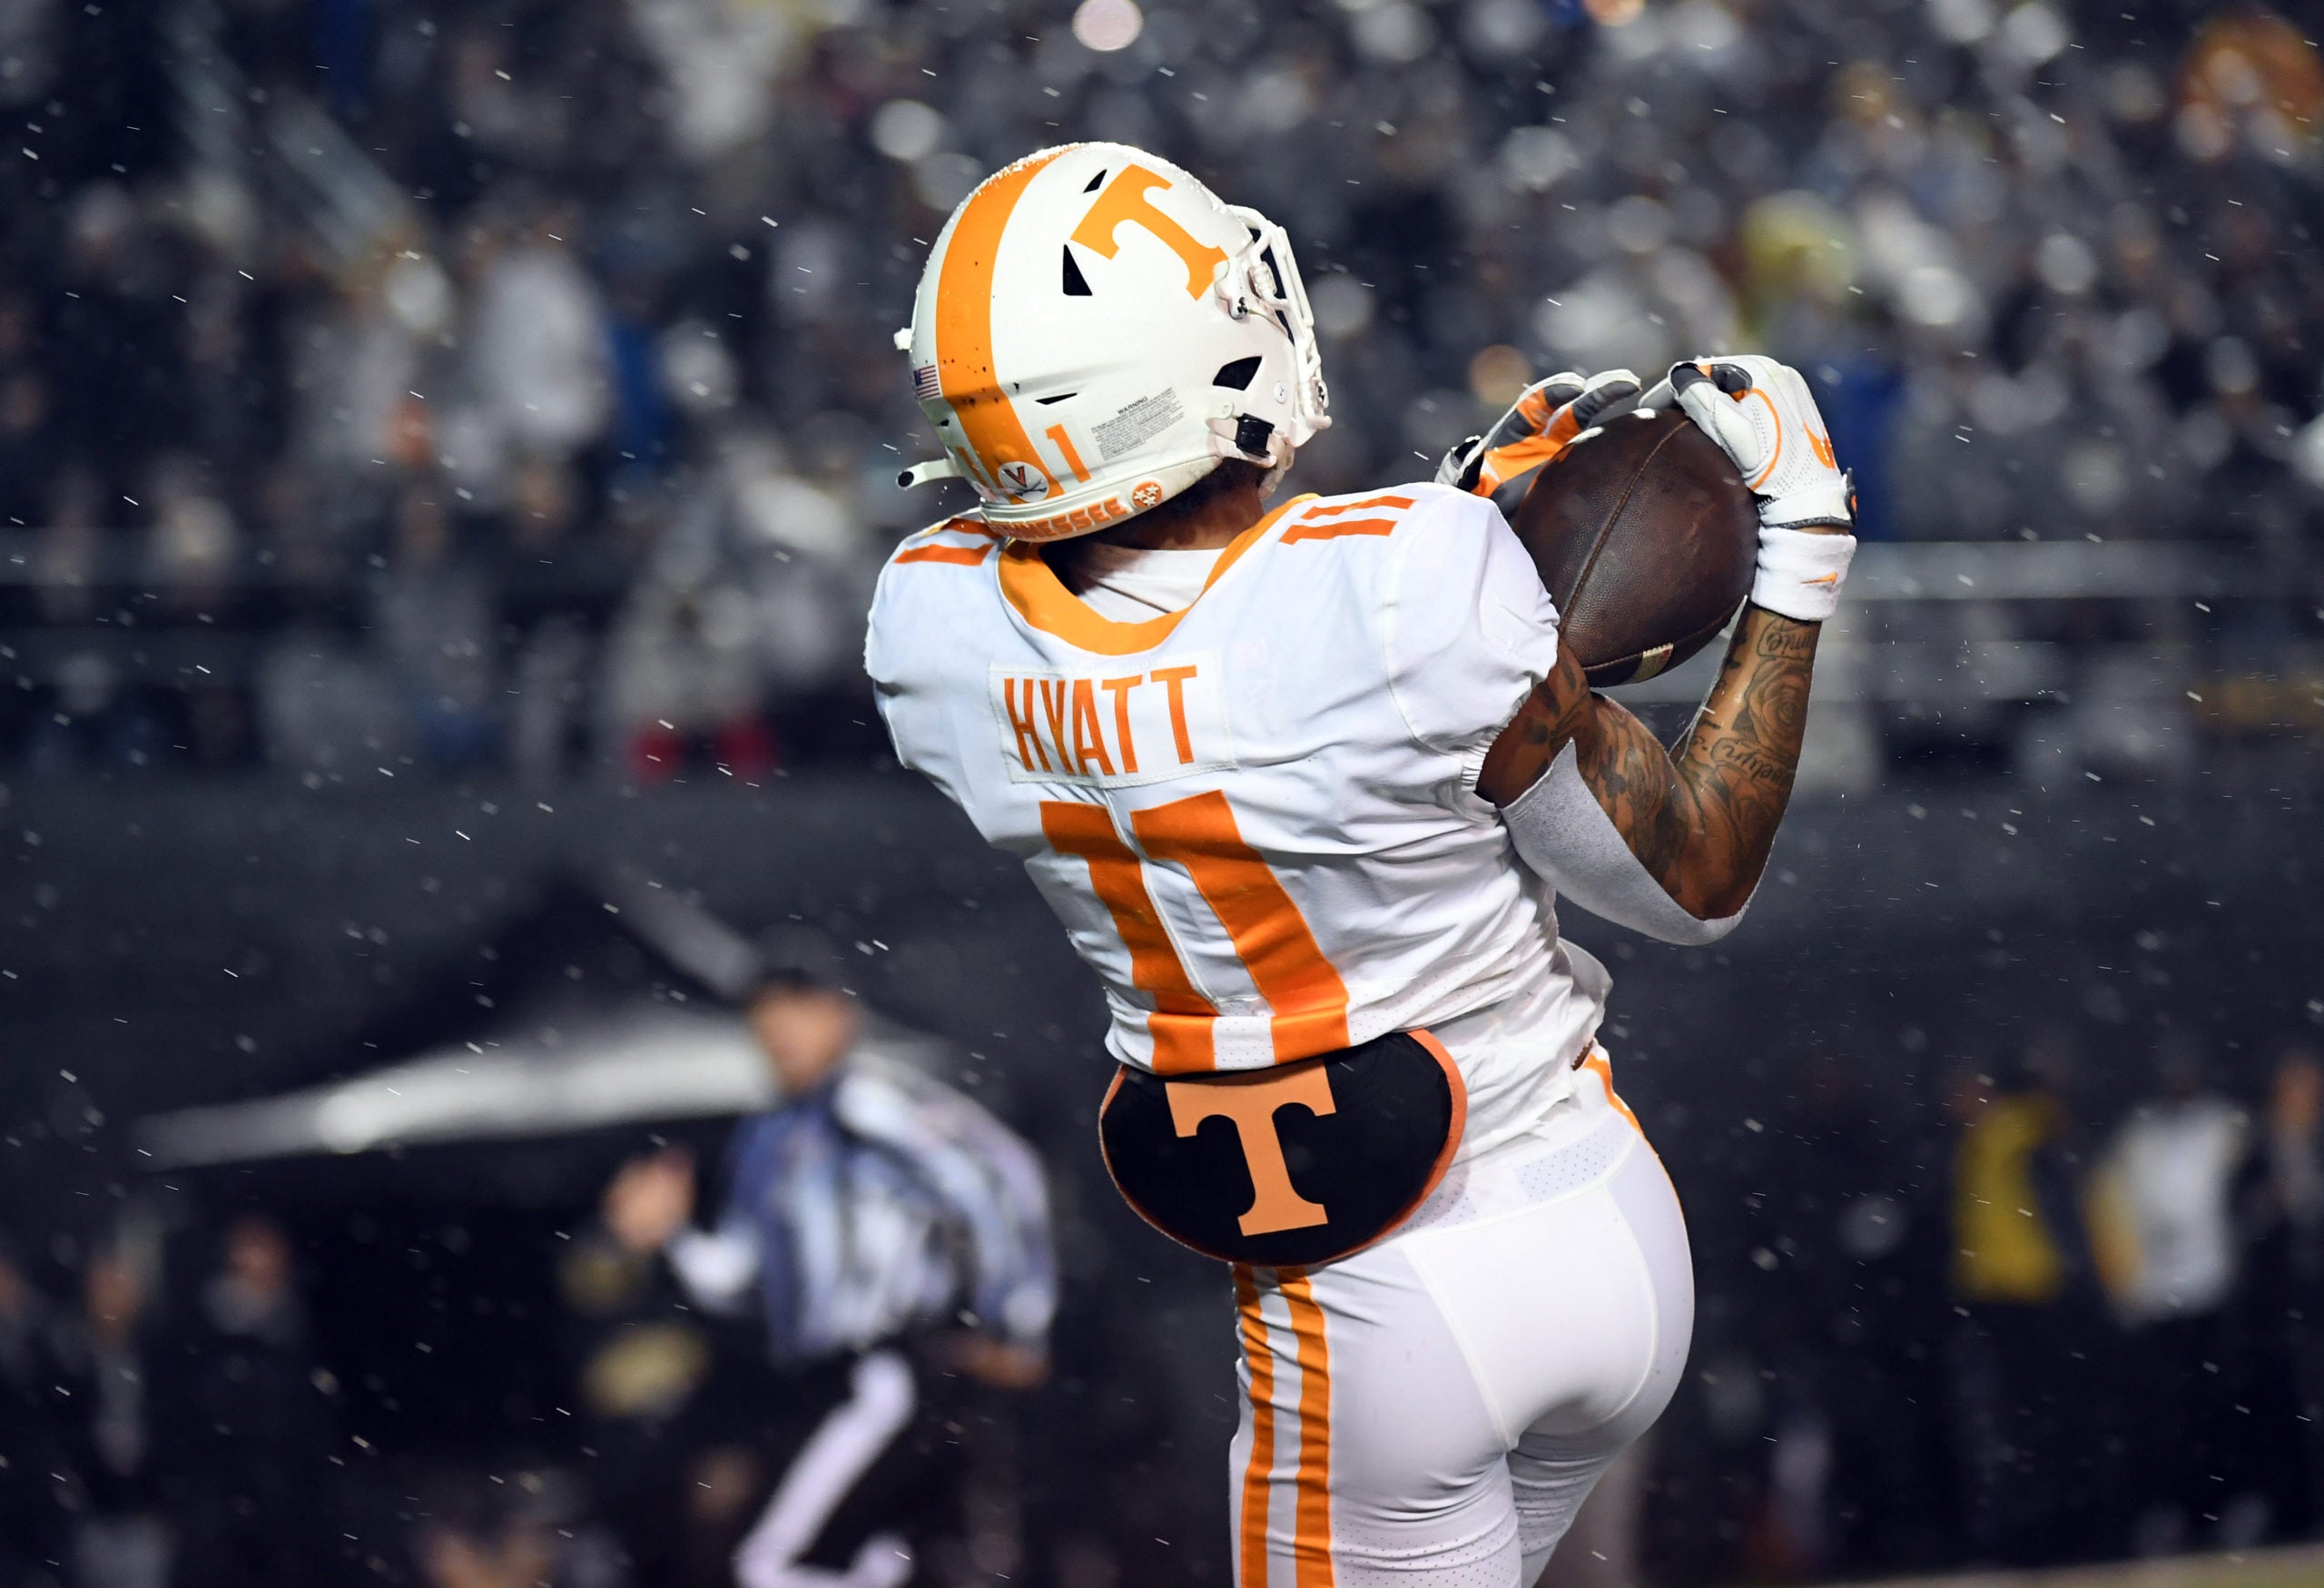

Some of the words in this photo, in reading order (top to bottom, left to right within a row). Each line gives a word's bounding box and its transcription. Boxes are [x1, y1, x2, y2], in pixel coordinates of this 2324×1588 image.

[1069, 163, 1229, 301] T
[1117, 395, 1148, 415] WARNING
[1003, 465, 1028, 488] V
[1046, 423, 1091, 483] 1
[1278, 495, 1417, 546] 11
[1004, 665, 1197, 775] HYATT
[1039, 789, 1351, 1075] 11
[1165, 1058, 1336, 1237] T
